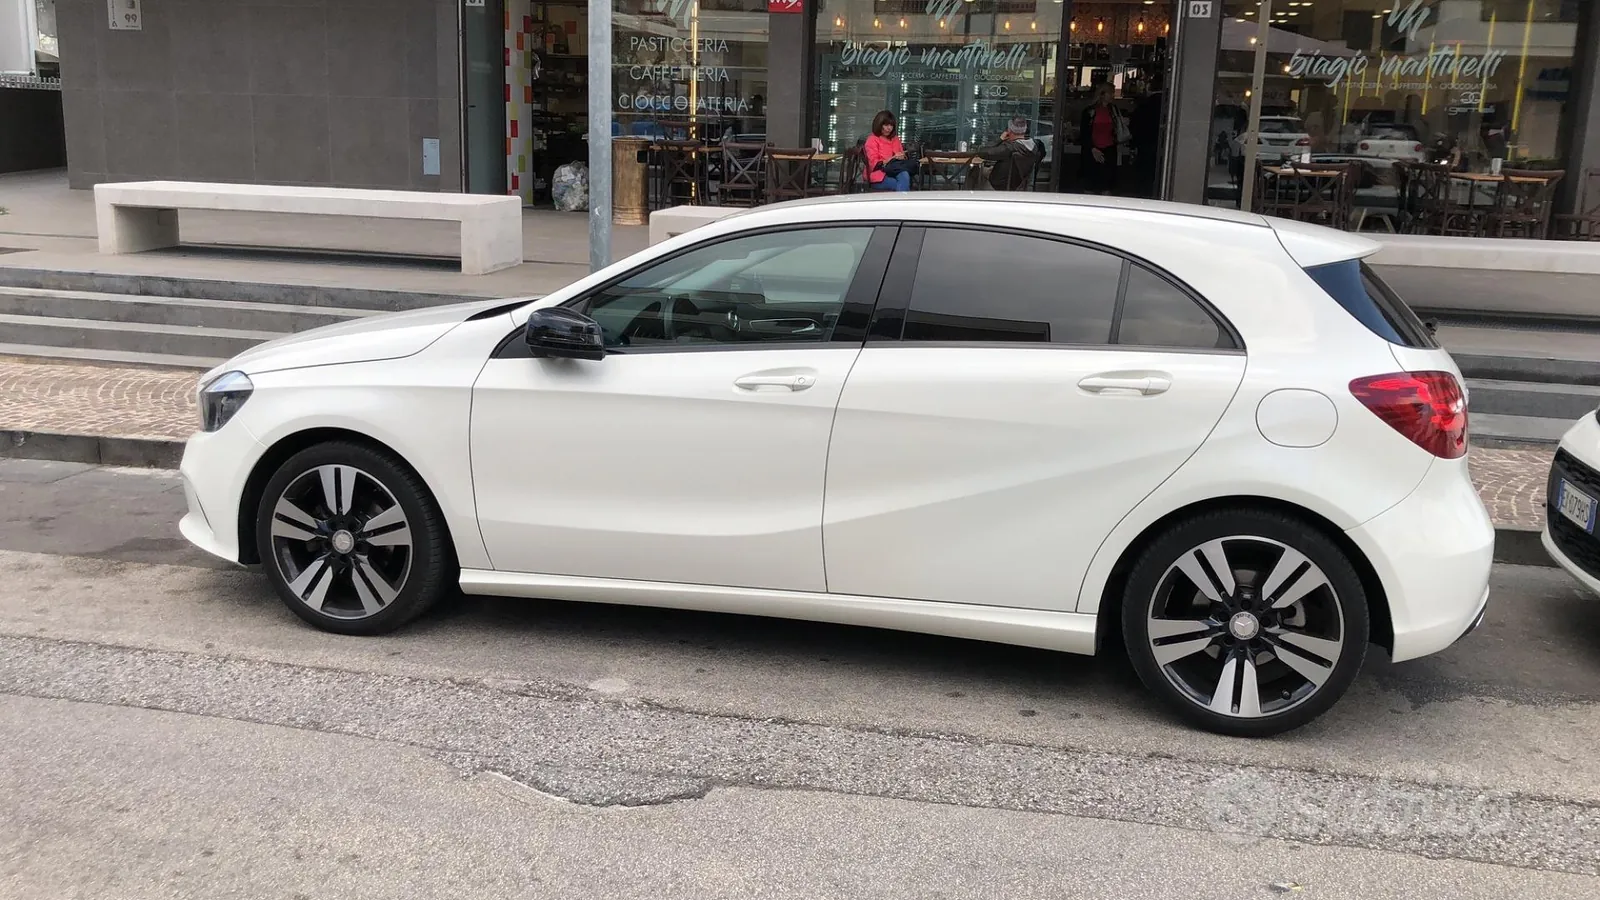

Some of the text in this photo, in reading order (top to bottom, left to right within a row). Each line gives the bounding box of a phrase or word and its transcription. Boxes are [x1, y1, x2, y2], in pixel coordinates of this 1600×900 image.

[630, 36, 730, 53] PASTICCERIA
[841, 38, 1031, 78] biagio martinelli
[1288, 45, 1508, 88] biagio martinelli
[630, 65, 730, 82] CAFFETTERIA
[618, 94, 749, 112] CIOCCOATERIA
